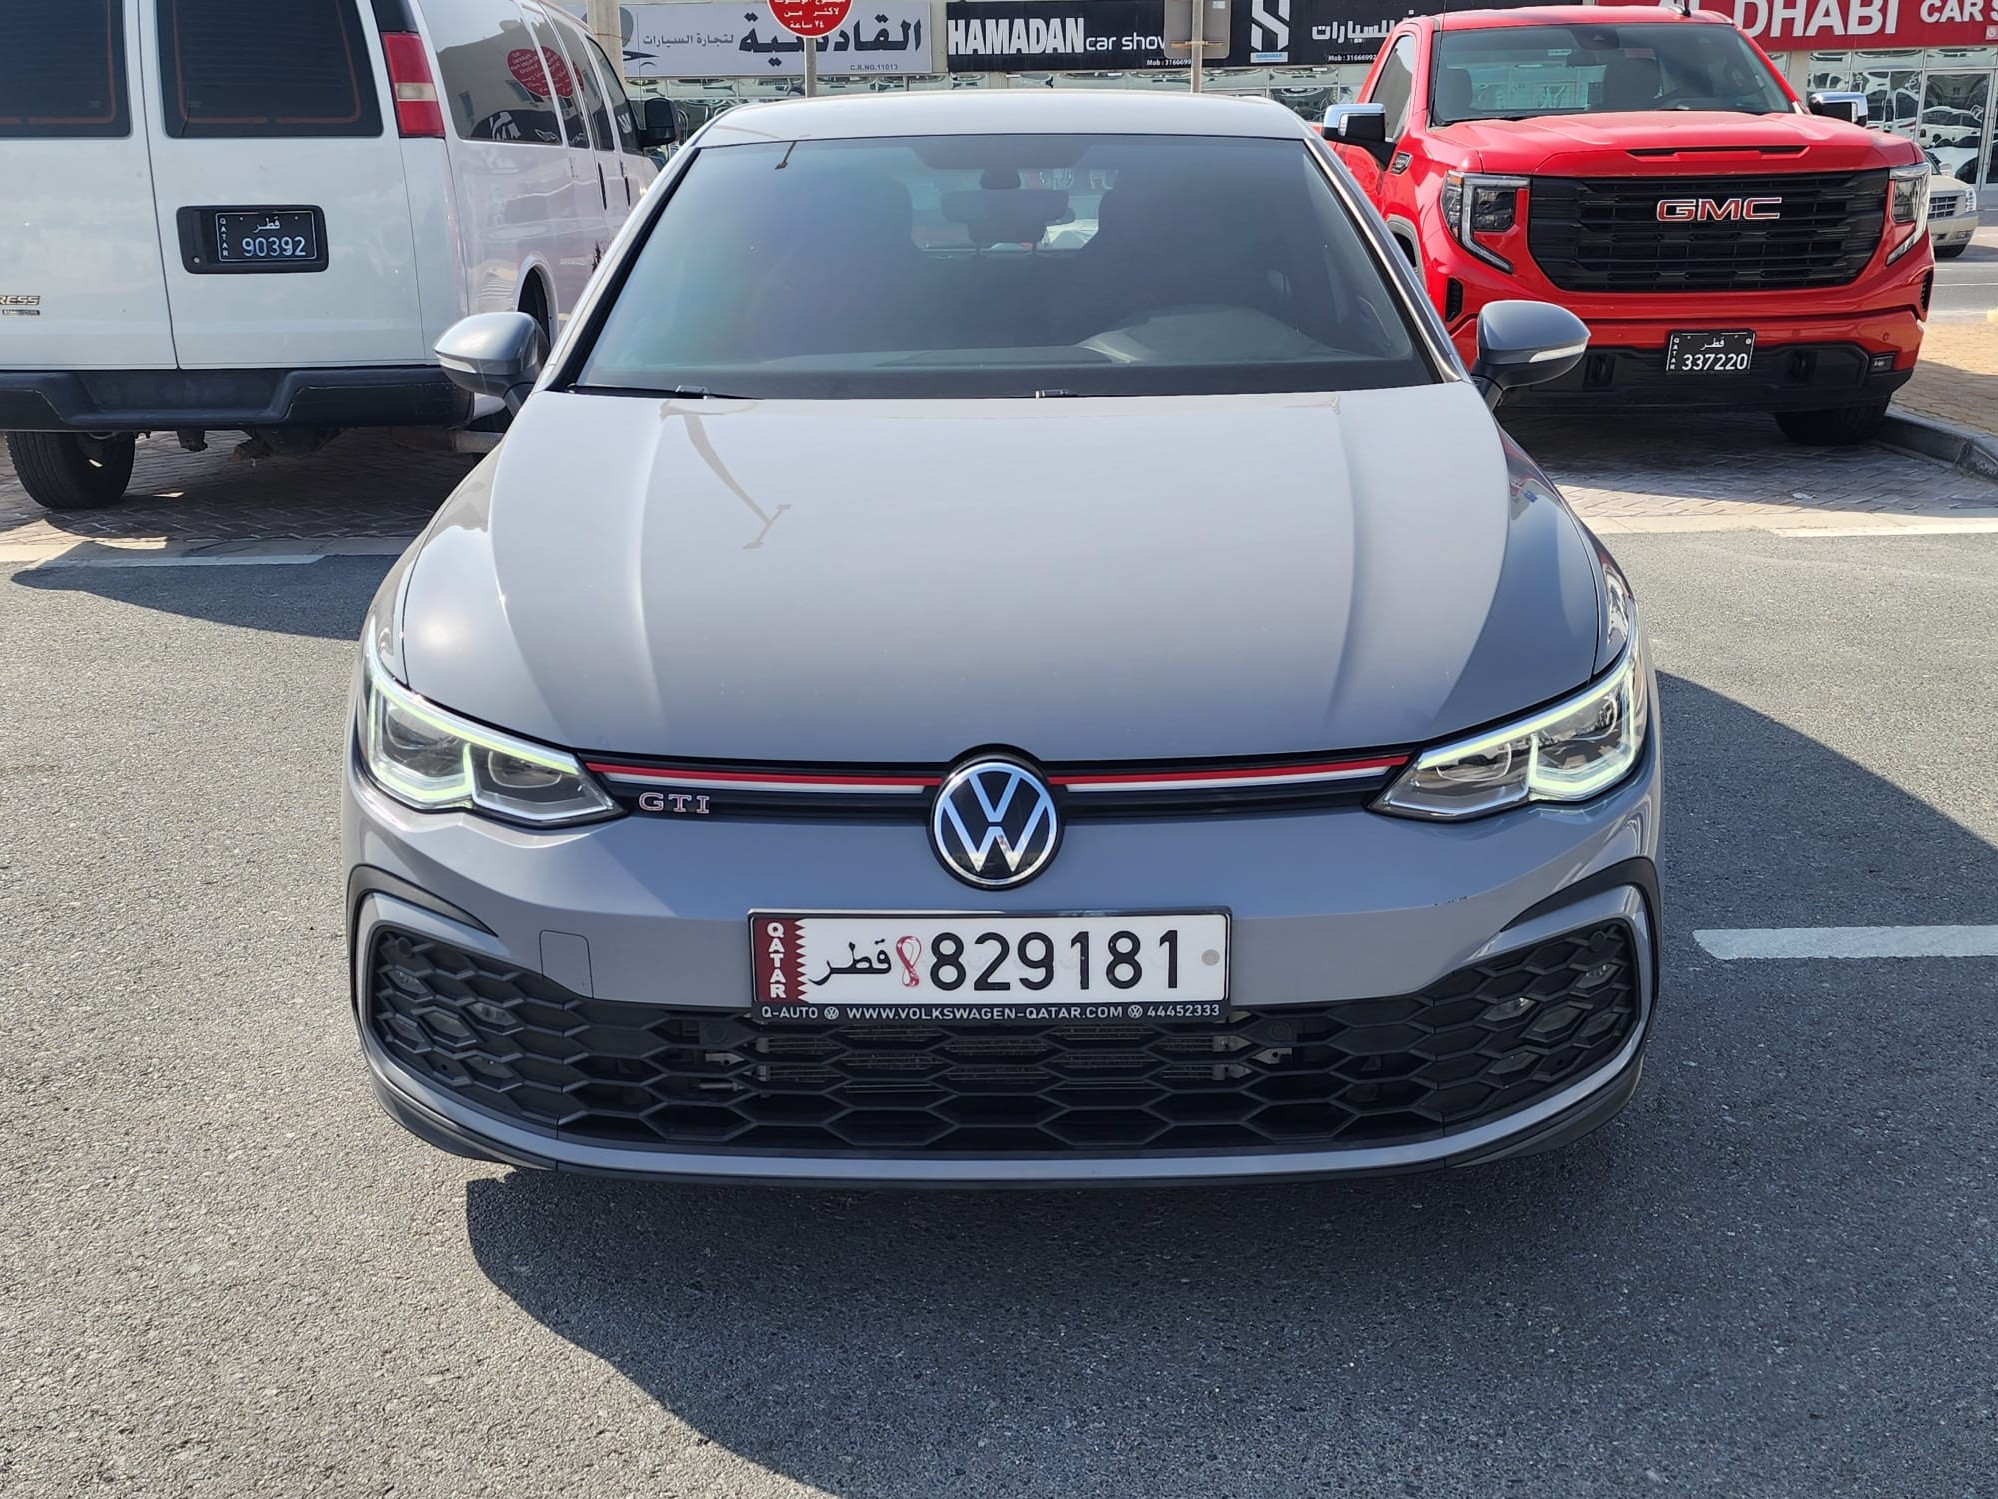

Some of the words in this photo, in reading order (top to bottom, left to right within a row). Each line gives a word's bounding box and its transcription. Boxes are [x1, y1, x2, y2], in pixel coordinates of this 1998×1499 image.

[783, 9, 803, 17] من
[1733, 0, 1899, 38] DHABI
[1920, 0, 1984, 23] CAR
[642, 34, 694, 48] السيارات
[696, 32, 734, 48] لتجارة
[947, 17, 1085, 56] HAMADAN
[1085, 36, 1117, 51] car
[1656, 197, 1783, 222] GMC
[253, 216, 280, 233] قطر
[219, 217, 229, 257] QATAR
[242, 236, 306, 257] 90392
[1669, 337, 1680, 370] QATAR
[1700, 336, 1725, 351] قطر
[1681, 353, 1748, 371] 337220
[638, 792, 710, 814] GTI
[765, 921, 787, 999] QATAR
[807, 938, 893, 987] قطر
[930, 930, 1179, 991] 829181
[761, 1006, 819, 1020] Q-AUTO
[847, 1006, 1123, 1020] WWW.VOLKSWAGEN-QATAR.COM
[1147, 1004, 1220, 1018] 44452333
